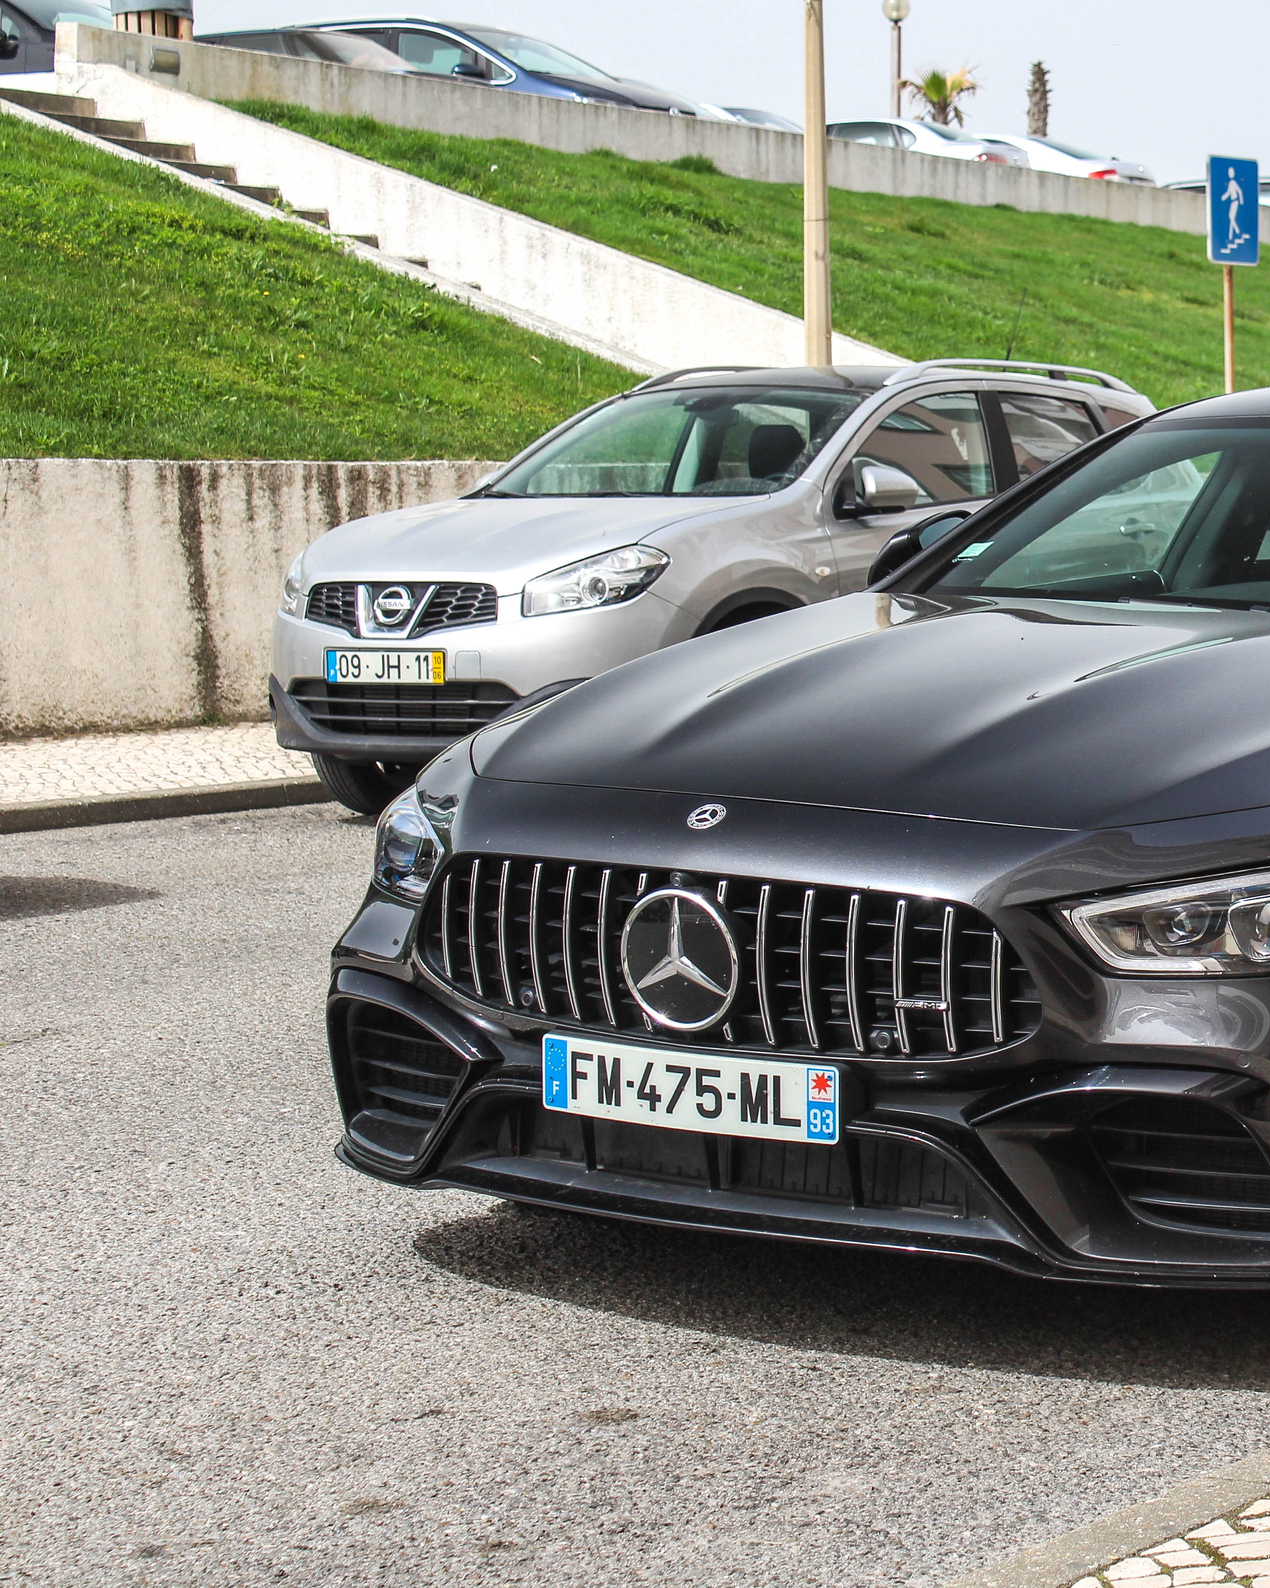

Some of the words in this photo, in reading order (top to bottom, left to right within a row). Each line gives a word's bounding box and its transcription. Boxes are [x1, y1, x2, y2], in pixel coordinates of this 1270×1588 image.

[330, 669, 335, 677] P
[552, 1080, 560, 1096] F
[571, 1051, 802, 1128] FM-475-ML
[809, 1108, 834, 1134] 93
